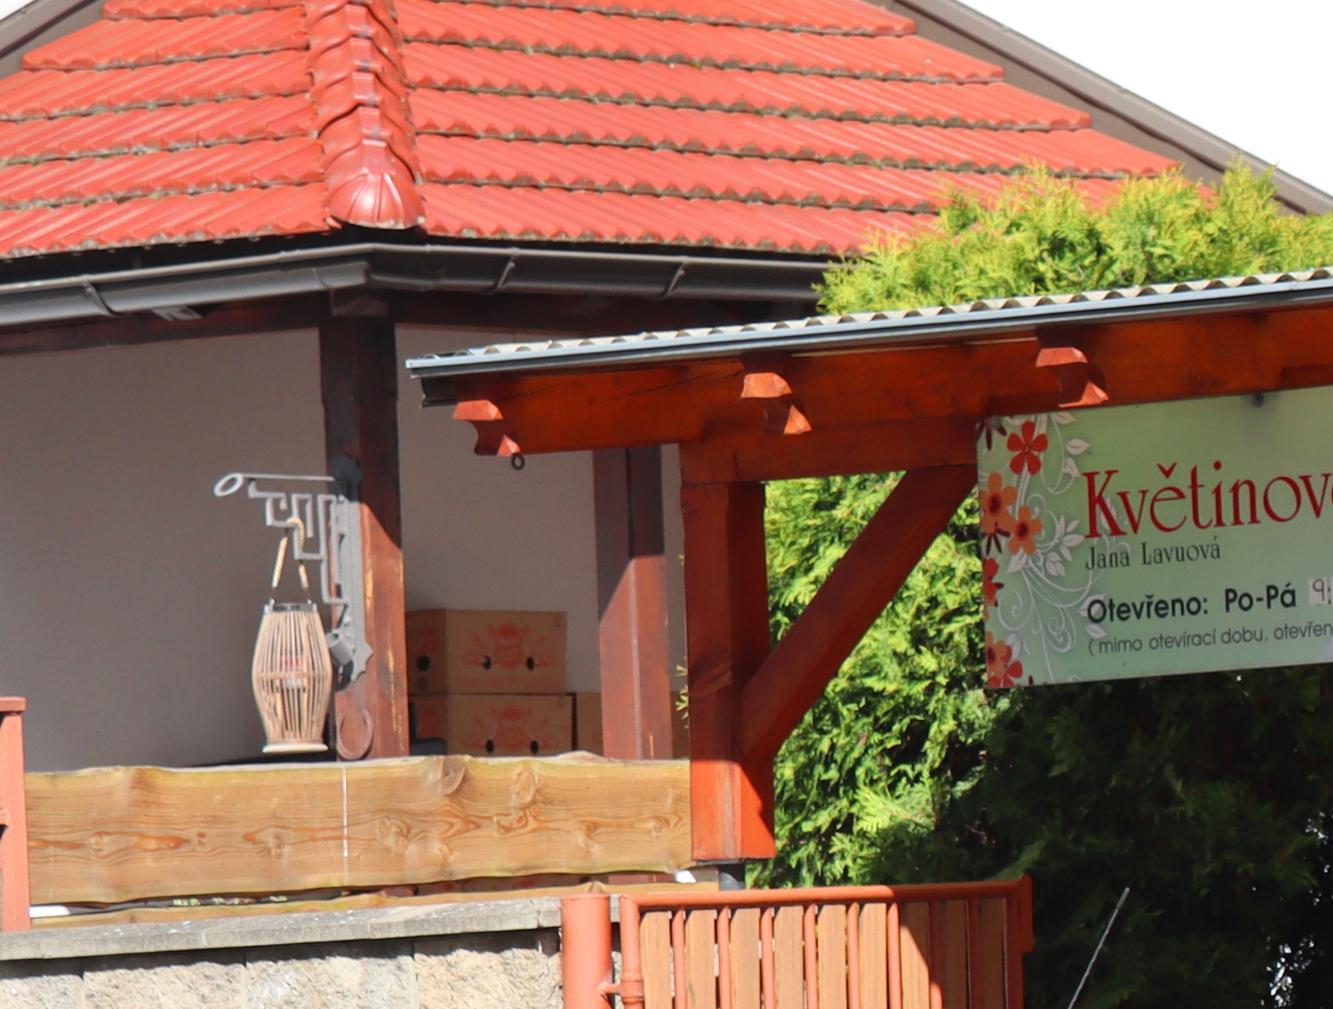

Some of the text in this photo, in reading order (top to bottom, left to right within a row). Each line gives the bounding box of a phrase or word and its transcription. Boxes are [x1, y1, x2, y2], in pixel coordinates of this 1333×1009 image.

[1085, 536, 1221, 570] Jana Lavuová
[1087, 593, 1208, 624] Otevřeno:
[1225, 581, 1297, 612] Po-Pá
[1149, 630, 1216, 650] otevírací
